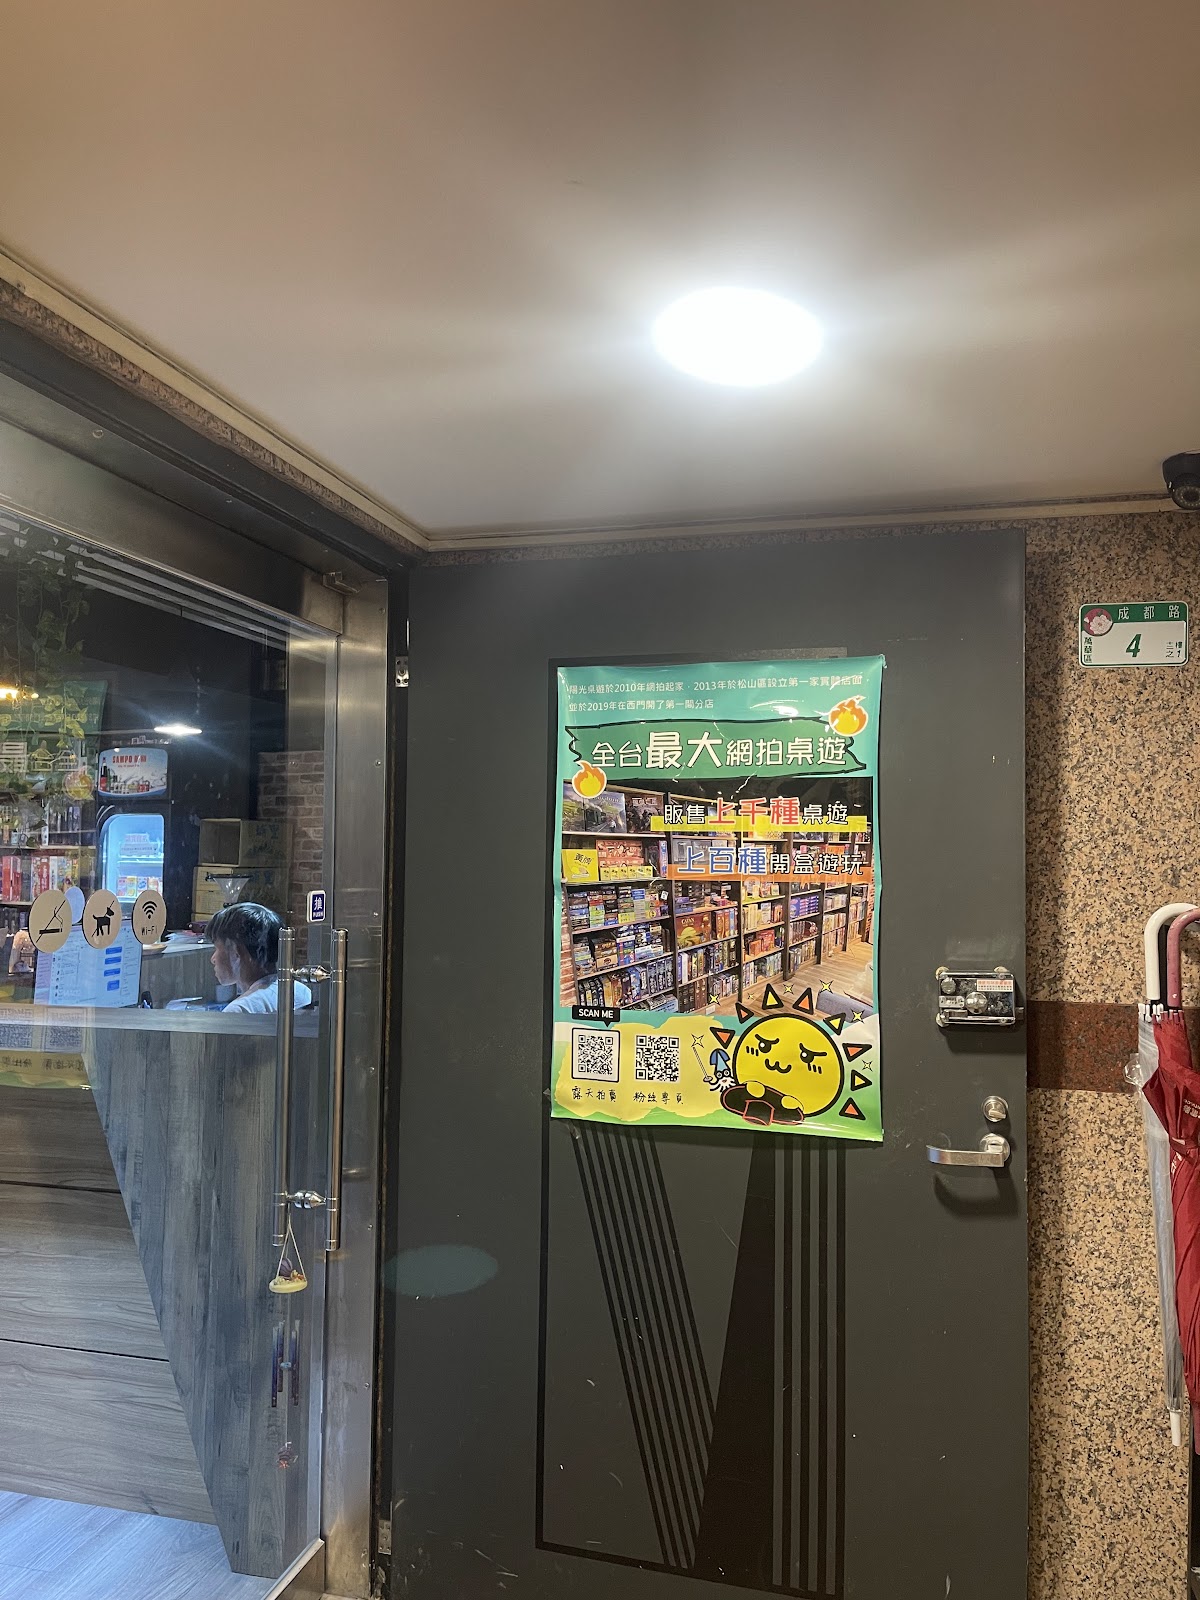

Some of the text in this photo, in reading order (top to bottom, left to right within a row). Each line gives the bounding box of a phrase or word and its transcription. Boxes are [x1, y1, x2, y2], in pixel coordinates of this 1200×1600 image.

[1118, 605, 1180, 620] 成都路
[1126, 634, 1141, 657] 4
[591, 731, 847, 769] 全台最大網拍桌遊
[112, 755, 133, 763] SAMPO
[664, 796, 849, 826] 販售上千種桌遊
[677, 845, 863, 876] 上百種開盒遊玩
[313, 896, 323, 910] 推
[578, 1008, 614, 1019] SCAN ME
[633, 1091, 684, 1105] 粉絲專頁
